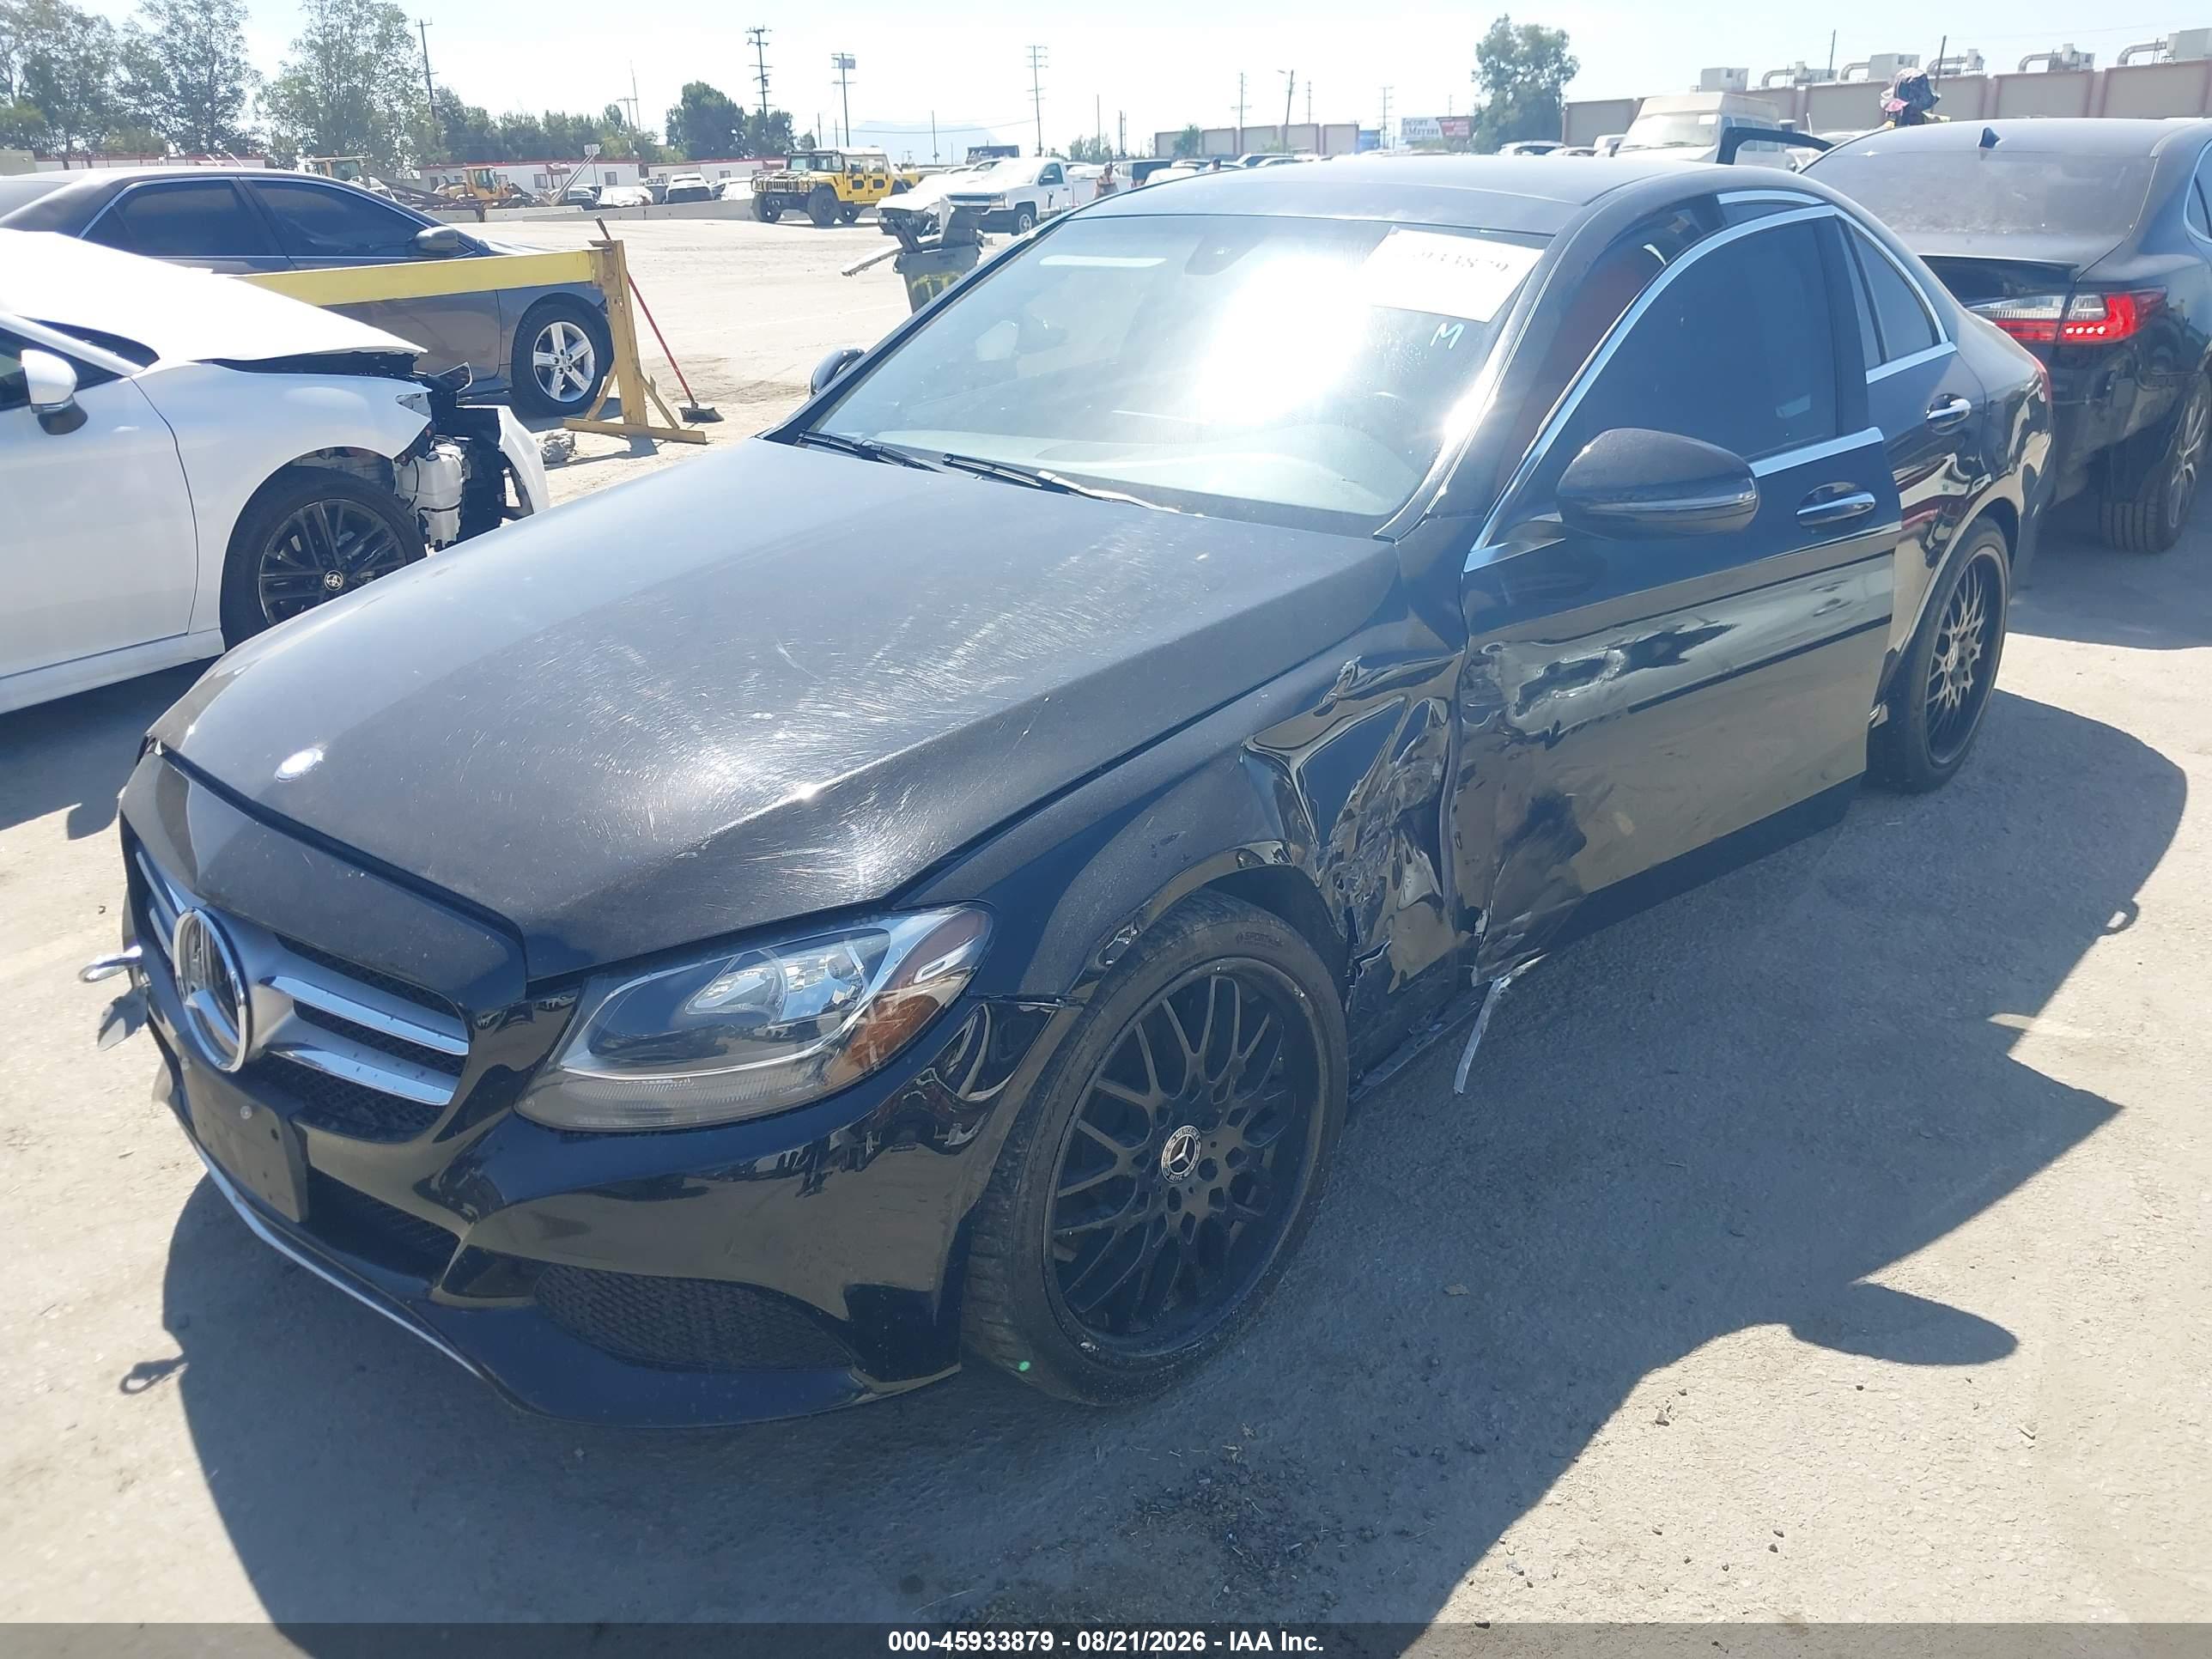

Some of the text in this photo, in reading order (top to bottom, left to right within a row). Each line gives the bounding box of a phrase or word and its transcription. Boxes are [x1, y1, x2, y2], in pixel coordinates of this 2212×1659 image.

[1430, 322, 1465, 349] M
[1175, 1127, 1200, 1141] MERCEDES
[1169, 1174, 1183, 1182] BENZ
